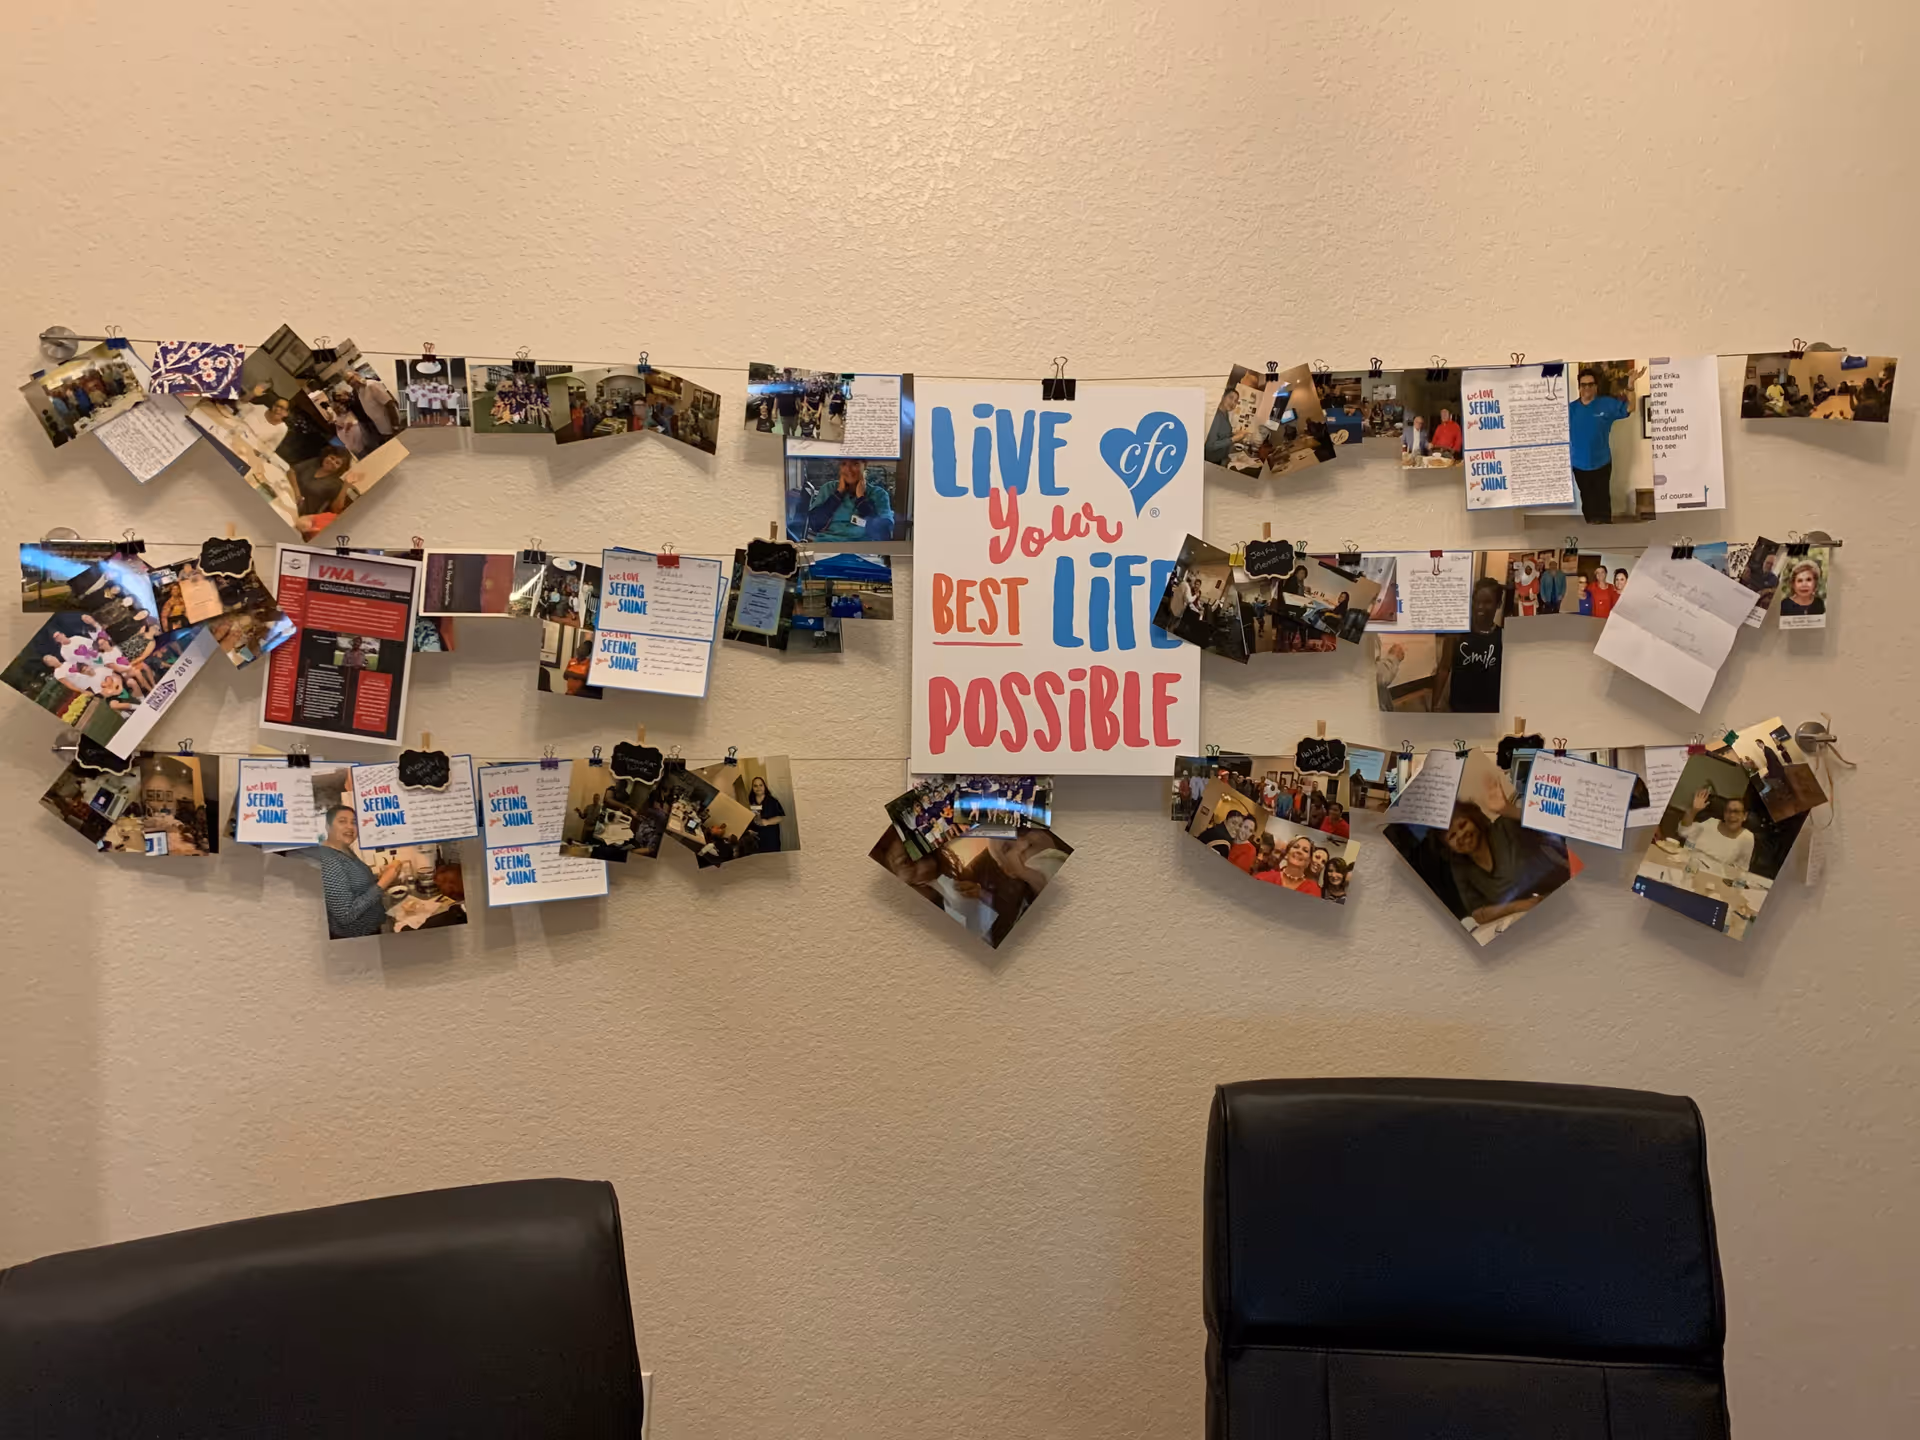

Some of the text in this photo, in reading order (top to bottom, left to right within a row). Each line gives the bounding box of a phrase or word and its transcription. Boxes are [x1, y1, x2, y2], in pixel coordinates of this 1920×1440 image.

[1469, 400, 1500, 415] SEEING
[1479, 415, 1506, 430] SHINE
[1120, 421, 1176, 491] cfc
[1471, 461, 1503, 476] SEEING
[1481, 476, 1508, 491] SHINE
[988, 485, 1123, 564] Your
[319, 565, 354, 582] VNA
[608, 582, 645, 599] SEEING
[617, 598, 648, 615] SHINE
[932, 573, 1028, 636] BEST
[600, 639, 636, 656] SEEING
[1460, 642, 1496, 668] Smile
[175, 658, 193, 676] 2016
[608, 655, 640, 672] SHINE
[246, 793, 284, 807] SEEING
[1533, 782, 1565, 802] SEEING
[363, 795, 400, 812] SEEING
[490, 795, 528, 813] SEEING
[1539, 799, 1567, 817] SHINE
[256, 809, 288, 824] SHINE
[375, 810, 406, 827] SHINE
[503, 810, 534, 827] SHINE
[494, 853, 532, 871] SEEING
[506, 868, 537, 886] SHINE
